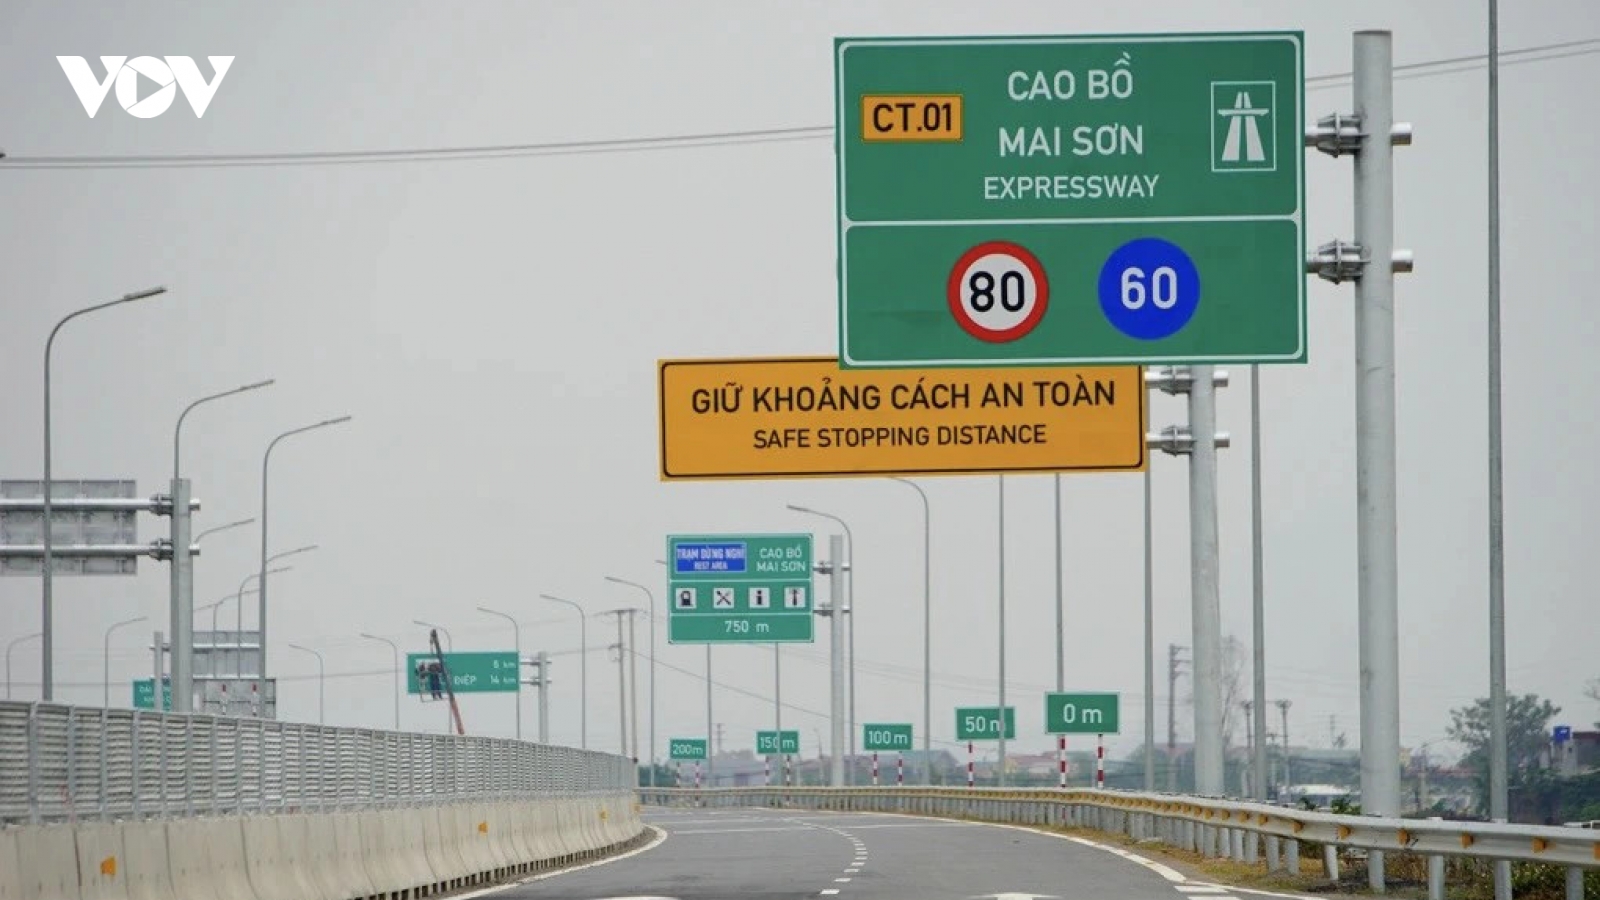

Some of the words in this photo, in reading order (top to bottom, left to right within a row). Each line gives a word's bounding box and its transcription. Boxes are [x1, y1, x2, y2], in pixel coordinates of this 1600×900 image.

[1007, 69, 1076, 101] CAO
[1087, 52, 1134, 99] BỒ
[873, 102, 953, 132] CT.01
[999, 126, 1061, 157] MAI
[1072, 123, 1143, 155] SƠN
[984, 175, 1160, 199] EXPRESSWAY
[969, 270, 1026, 313] 80
[1120, 266, 1178, 310] 60
[691, 379, 744, 413] GIỮ
[753, 377, 881, 412] KHOẢNG
[890, 377, 970, 409] CÁCH
[981, 382, 1024, 407] AN
[1038, 374, 1116, 406] TOÀN
[753, 429, 811, 449] SAFE
[817, 427, 930, 448] STOPPING
[937, 424, 1047, 445] DISTANCE
[760, 548, 783, 559] CAO
[756, 561, 778, 572] MAI
[725, 621, 749, 633] 750
[756, 623, 769, 633] m
[965, 717, 985, 732] 50
[1063, 704, 1075, 723] 0
[1082, 708, 1102, 723] m
